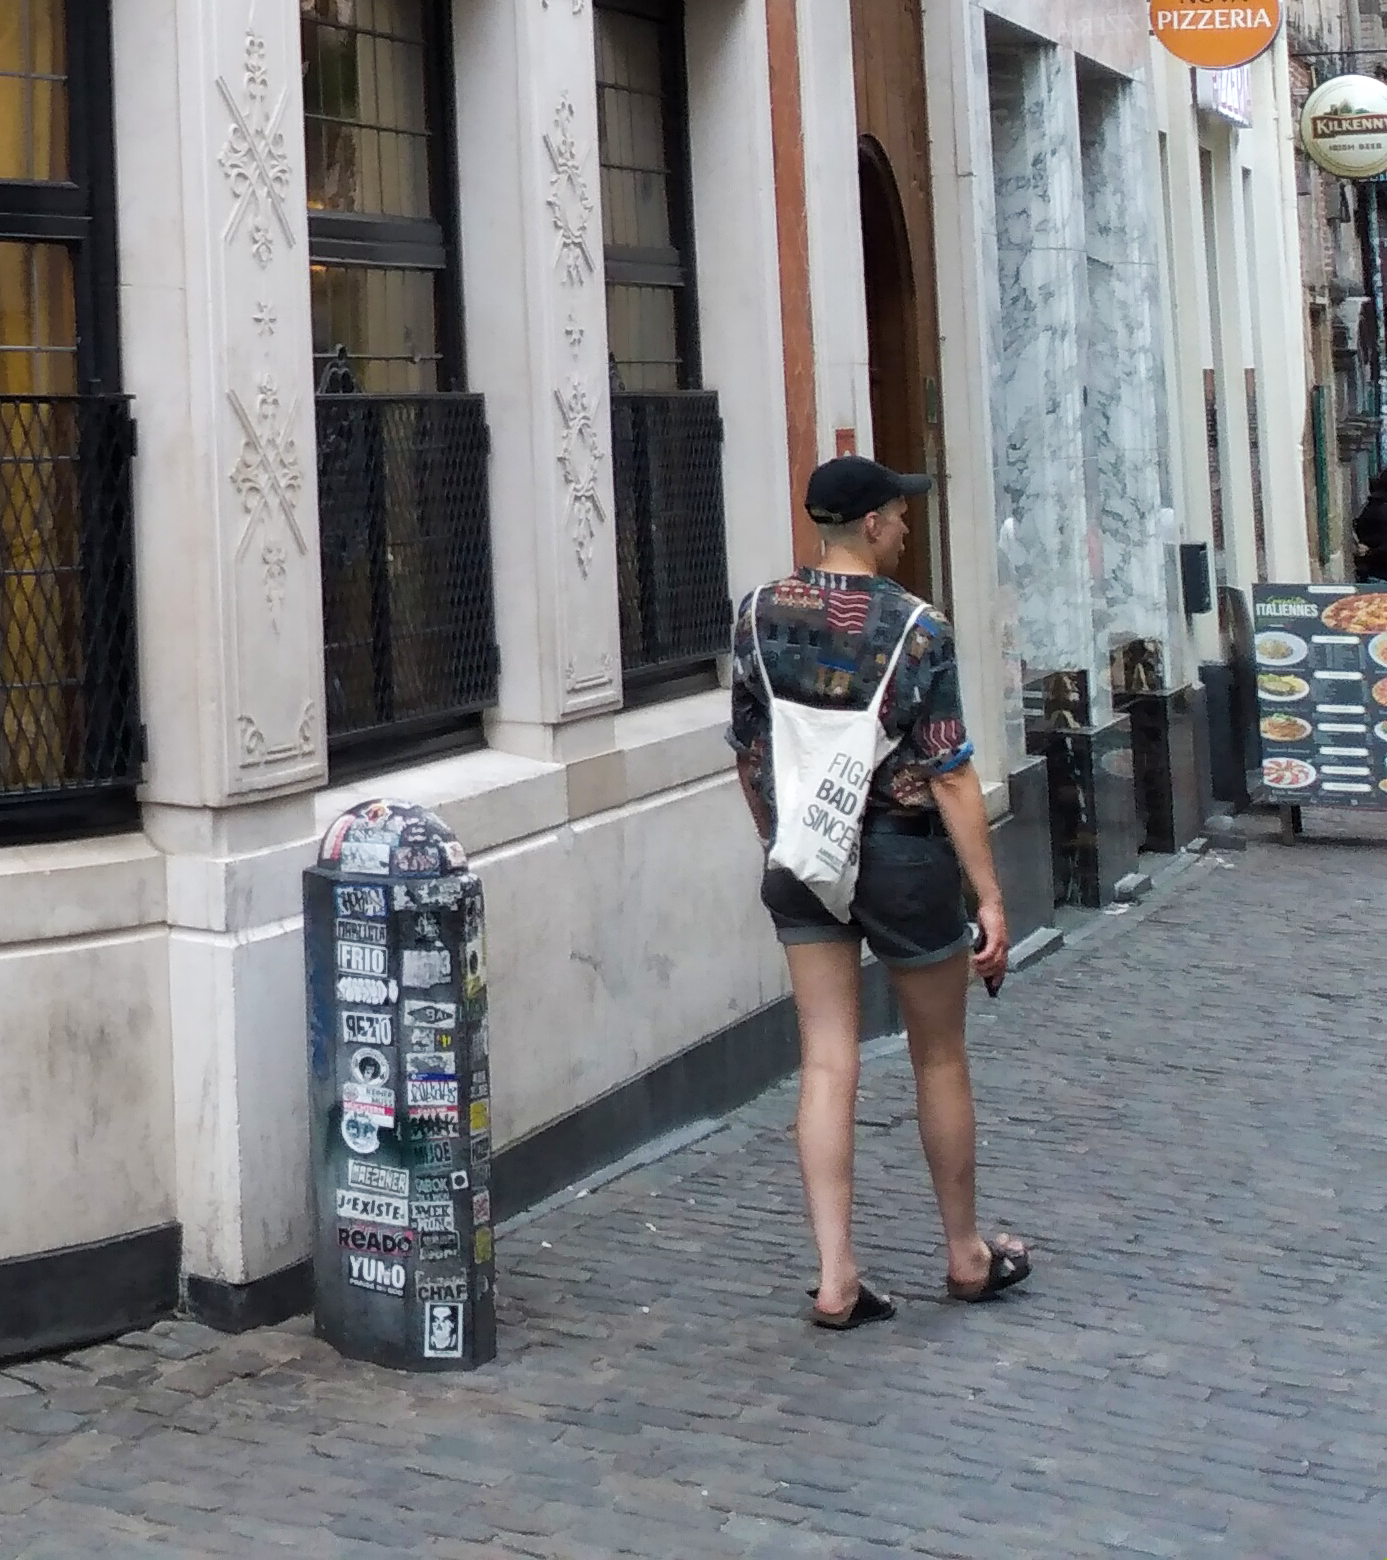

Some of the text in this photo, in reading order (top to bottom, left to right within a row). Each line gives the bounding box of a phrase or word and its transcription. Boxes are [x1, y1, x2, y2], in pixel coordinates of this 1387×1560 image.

[1158, 8, 1272, 30] PIZZERIA
[1255, 603, 1319, 617] ITALIENNES
[815, 778, 858, 816] BAD
[802, 803, 856, 851] SINCE
[341, 944, 385, 973] FRIO
